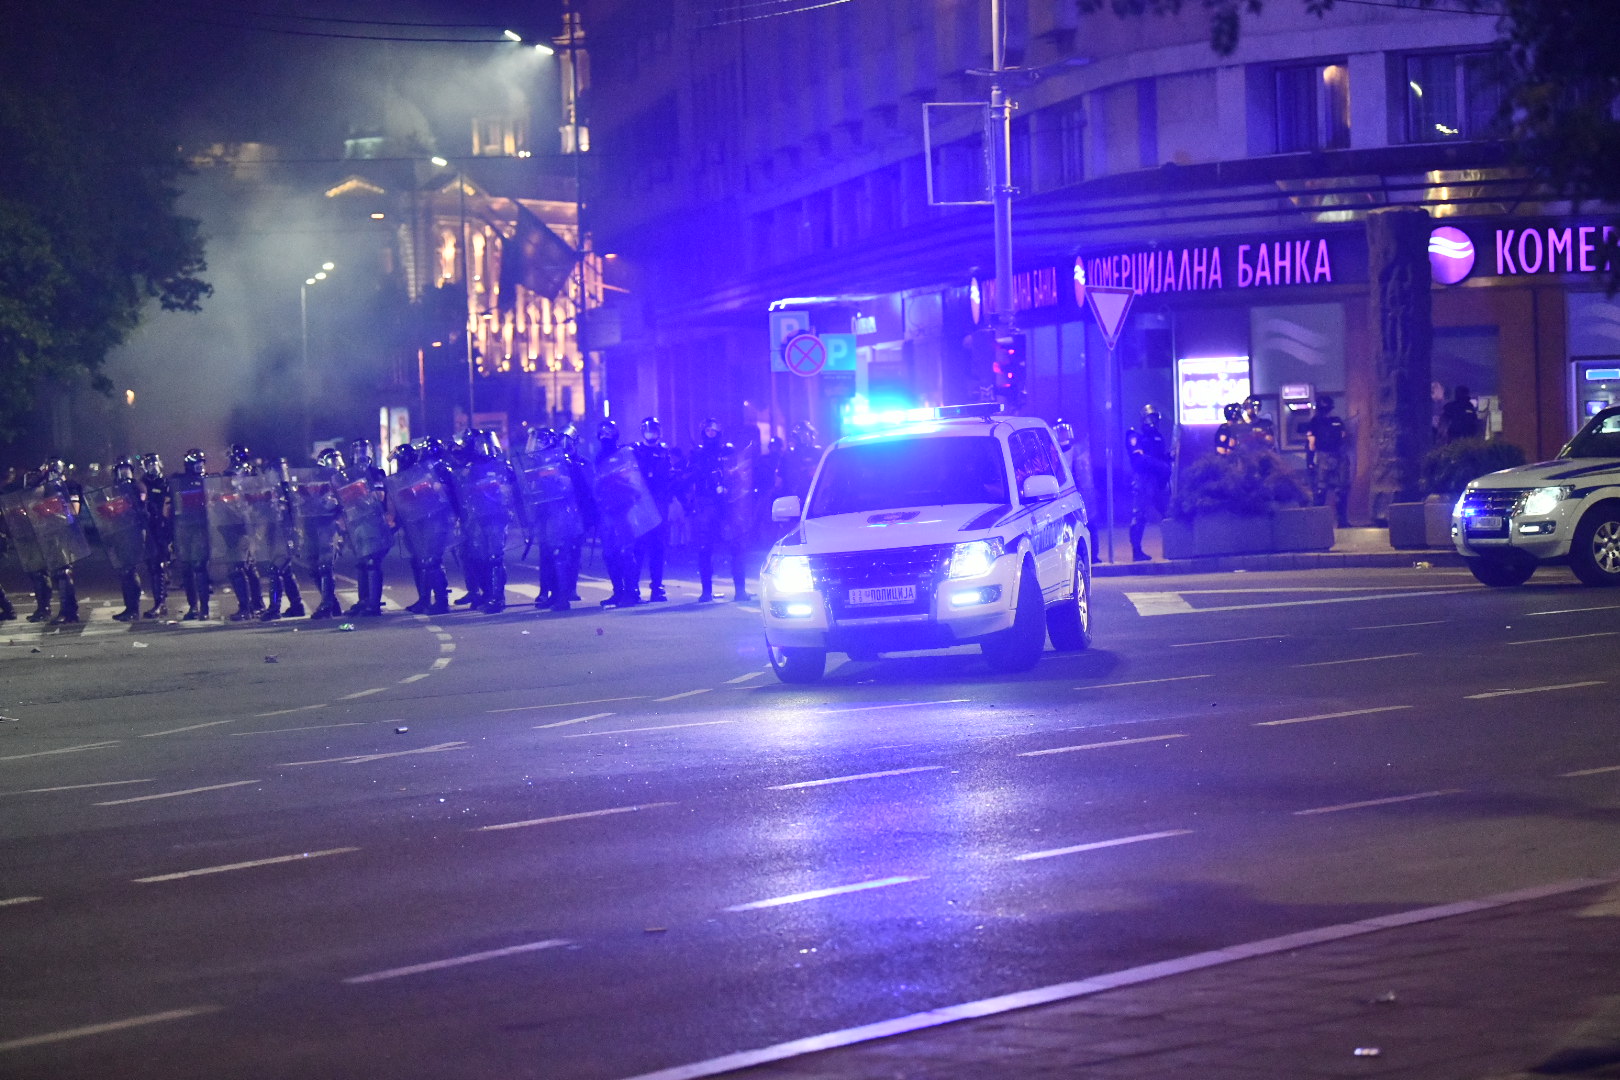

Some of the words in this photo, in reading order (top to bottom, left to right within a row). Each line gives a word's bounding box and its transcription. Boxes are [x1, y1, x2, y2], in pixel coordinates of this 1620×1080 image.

[1087, 246, 1223, 296] КОМЕРЦИЈАЛНА
[1237, 238, 1332, 288] БАНКА
[827, 338, 848, 367] P
[870, 586, 914, 601] ПОЛИЦИЈА
